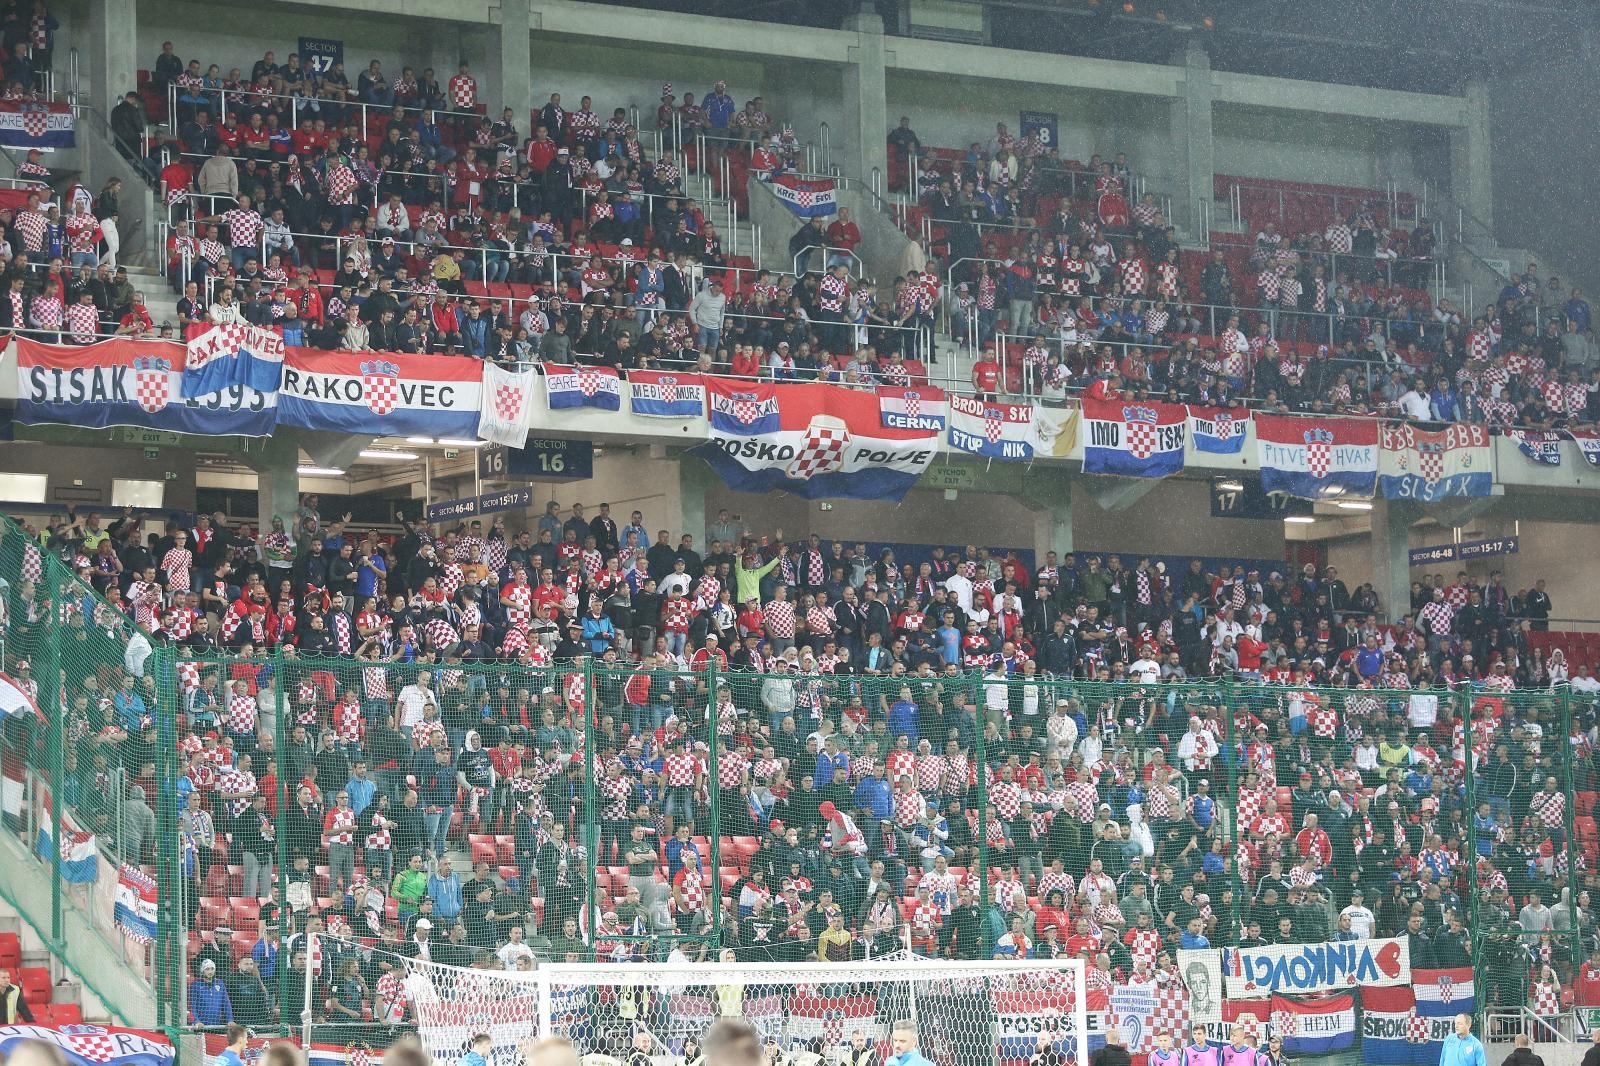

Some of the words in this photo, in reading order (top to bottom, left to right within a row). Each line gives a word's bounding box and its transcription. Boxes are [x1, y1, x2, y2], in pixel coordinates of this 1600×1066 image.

[305, 41, 337, 53] SECTOR
[30, 364, 130, 404] SISAK
[284, 369, 363, 402] RAKO
[400, 383, 455, 407] VEC
[952, 395, 984, 416] BROD
[1009, 407, 1032, 422] SKI
[887, 414, 942, 430] CERNA
[1195, 420, 1213, 434] IMO
[142, 434, 161, 442] EXIT
[1090, 421, 1119, 447] IMO
[533, 440, 567, 450] SECTOR
[952, 430, 983, 452] STUP
[1002, 442, 1026, 457] NIK
[485, 452, 503, 473] 16
[538, 452, 565, 473] 16
[853, 448, 931, 465] POLJE
[1265, 444, 1306, 466] PITVE
[1336, 448, 1371, 467] HVAR
[438, 506, 455, 516] SECTOR
[454, 501, 474, 513] 46-48
[482, 498, 499, 508] SECTOR
[499, 493, 519, 506] 15-17
[1218, 492, 1236, 511] 17
[1412, 551, 1431, 561] SECTOR
[1430, 548, 1453, 560] 46-48
[1461, 546, 1480, 555] SECTOR
[1480, 541, 1503, 553] 15-17
[1304, 1014, 1341, 1032] HEIM
